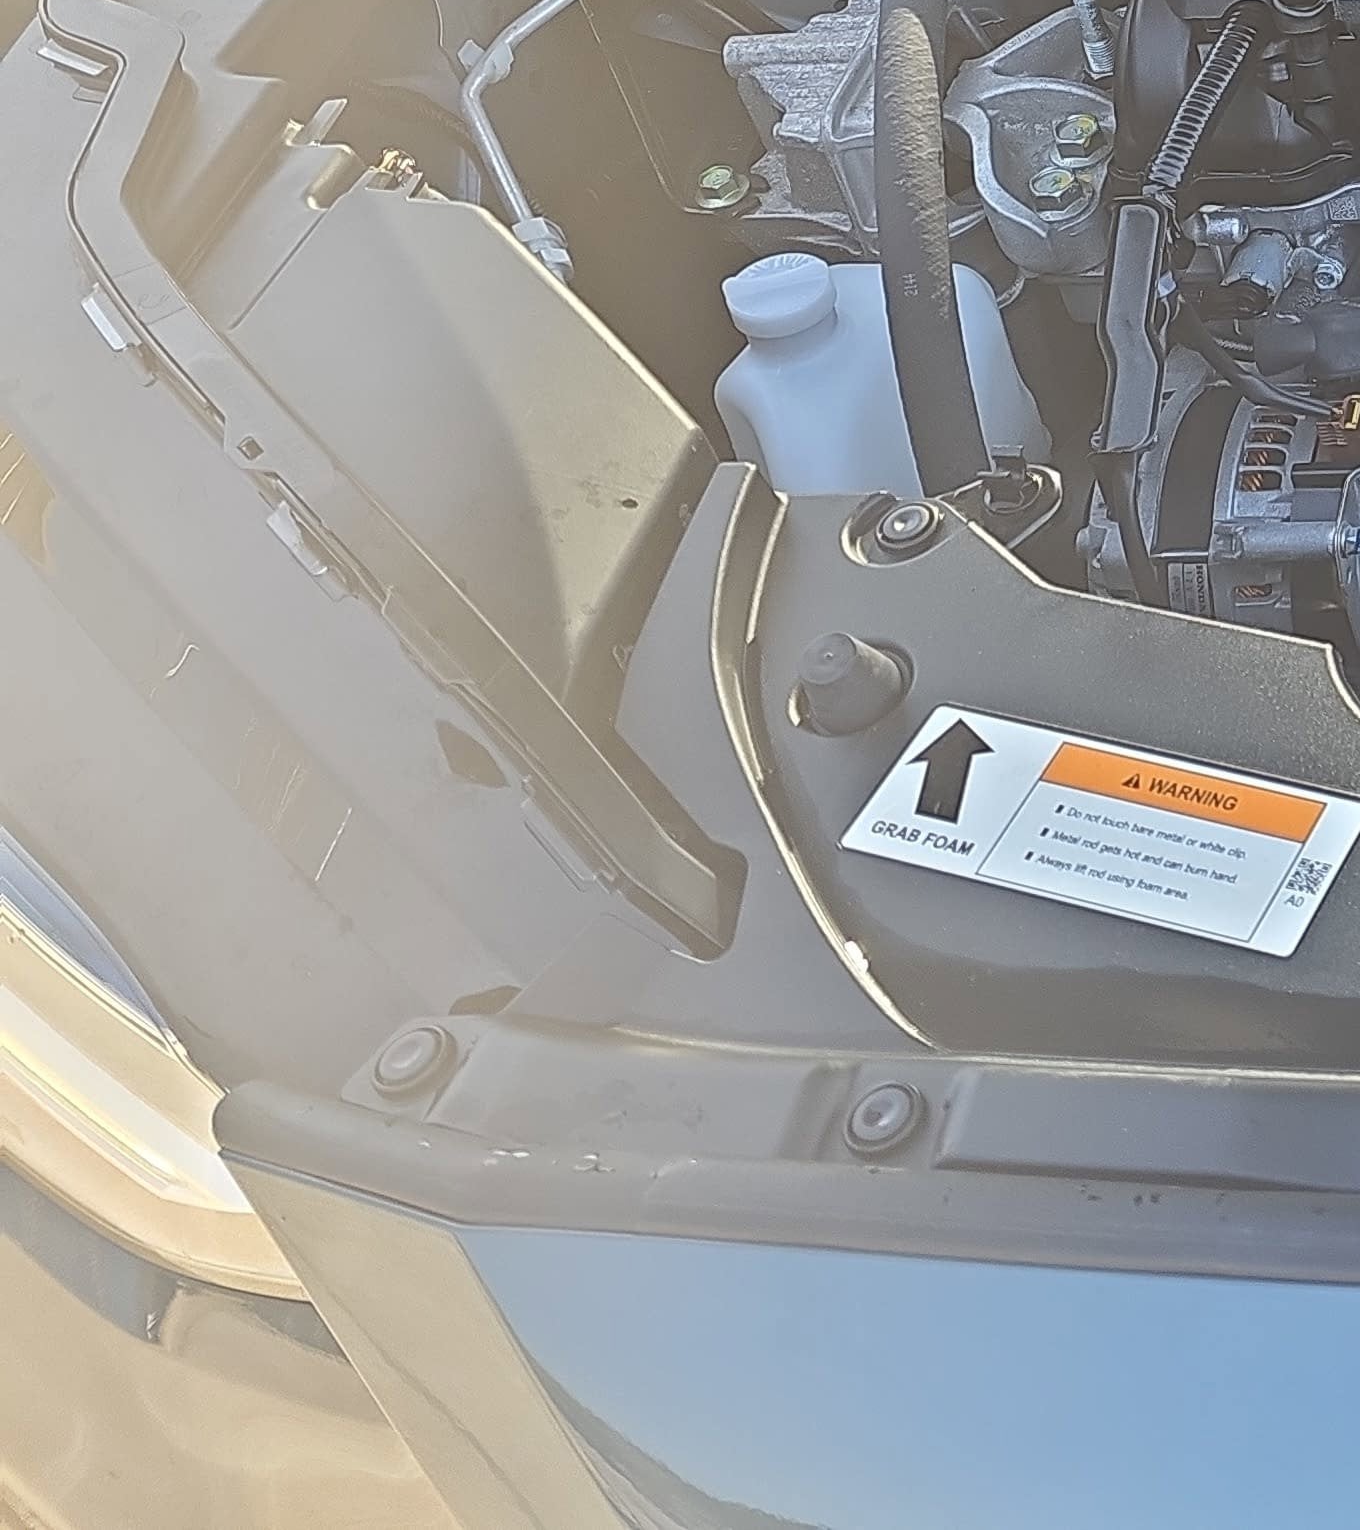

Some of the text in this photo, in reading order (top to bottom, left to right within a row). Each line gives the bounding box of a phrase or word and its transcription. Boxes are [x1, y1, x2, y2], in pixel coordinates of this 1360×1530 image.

[1149, 777, 1239, 811] WARNING
[871, 820, 976, 857] GRAB FOAM
[1067, 806, 1083, 819] Do
[1083, 813, 1101, 824] not
[1101, 816, 1130, 830] touch
[1131, 823, 1154, 837] bare
[1156, 831, 1186, 844] metal
[1186, 838, 1199, 847] or
[1200, 841, 1226, 854] white
[1036, 854, 1072, 871] Always
[1073, 863, 1088, 875] lift
[1088, 869, 1107, 880] rod
[1106, 873, 1135, 888] using
[1136, 879, 1163, 893] foam
[1052, 831, 1081, 844] Metal
[1081, 839, 1100, 850] rod
[1099, 844, 1122, 855] gets
[1123, 848, 1142, 860] hot
[1141, 854, 1163, 866] and
[1163, 859, 1183, 870] can
[1184, 864, 1209, 877] burn
